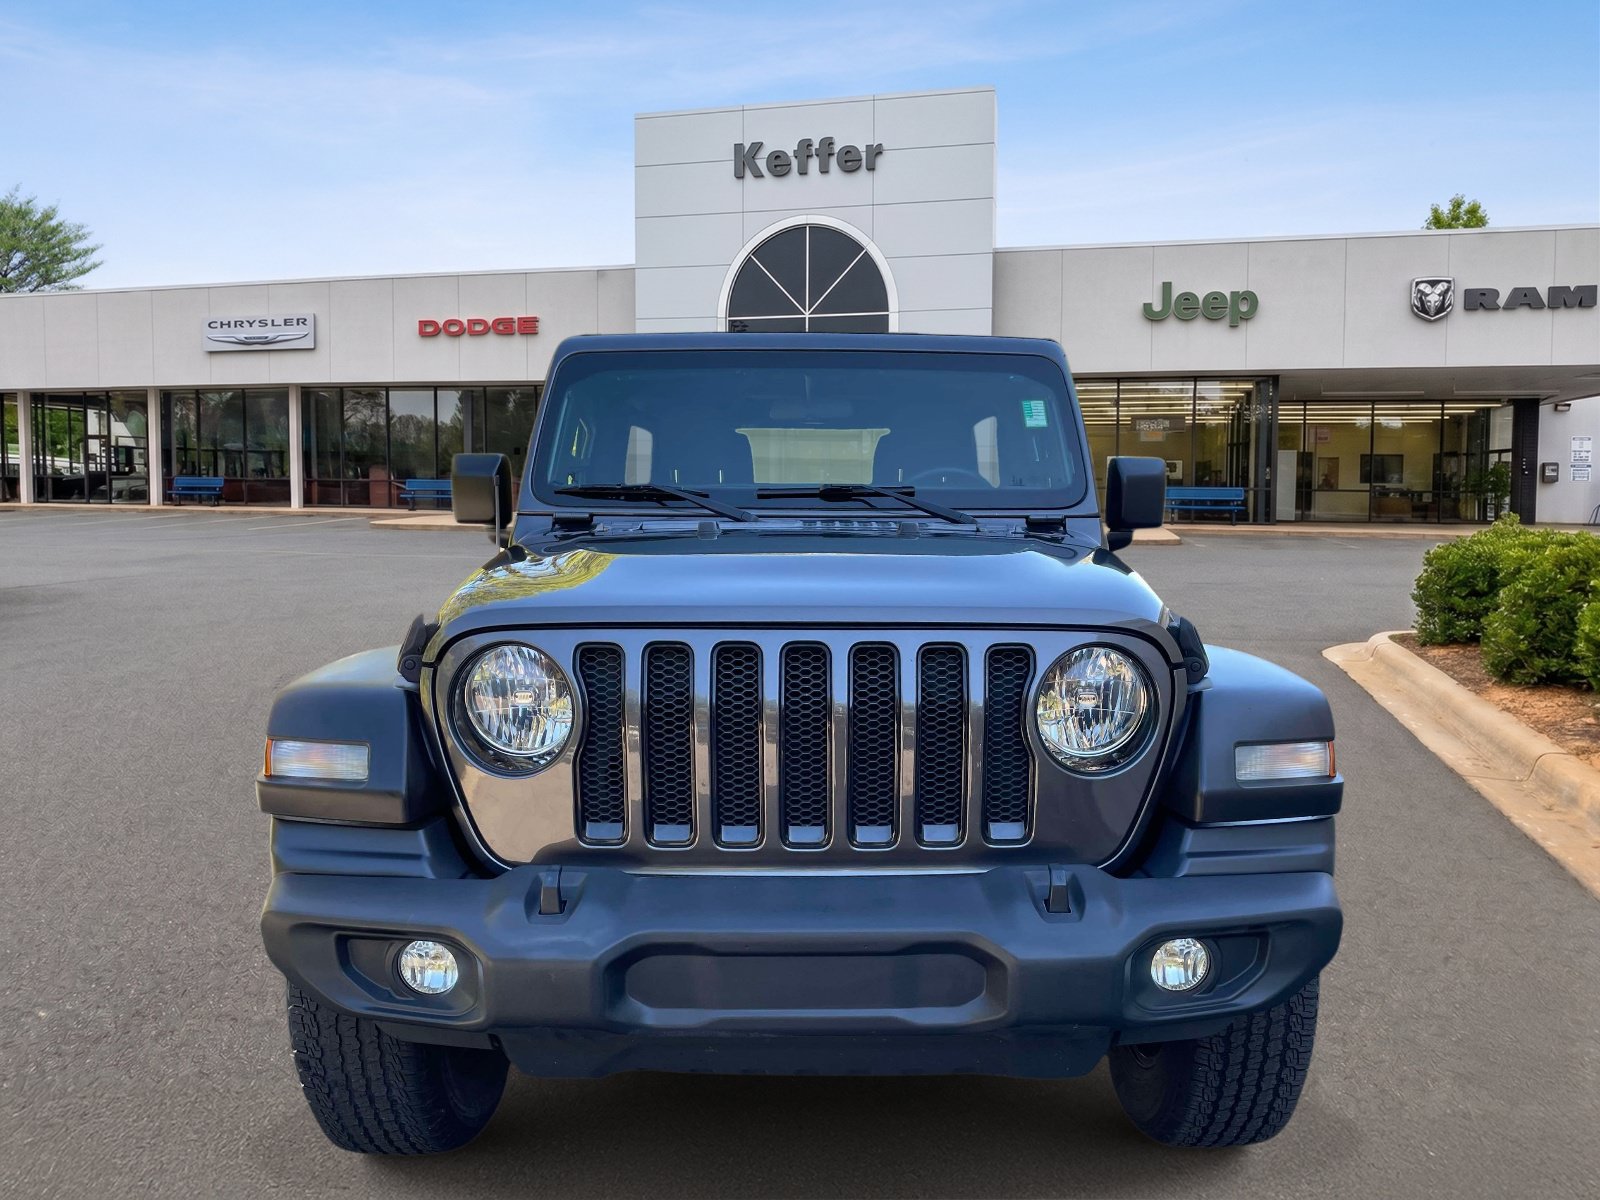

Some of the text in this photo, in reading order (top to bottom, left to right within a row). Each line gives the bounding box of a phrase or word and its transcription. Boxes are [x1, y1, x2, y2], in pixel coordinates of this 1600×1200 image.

[734, 137, 883, 178] Keffer
[1143, 282, 1259, 327] Jeep
[1464, 285, 1597, 310] RAM
[207, 317, 308, 329] CHRYSLER
[418, 317, 539, 337] DODGE
